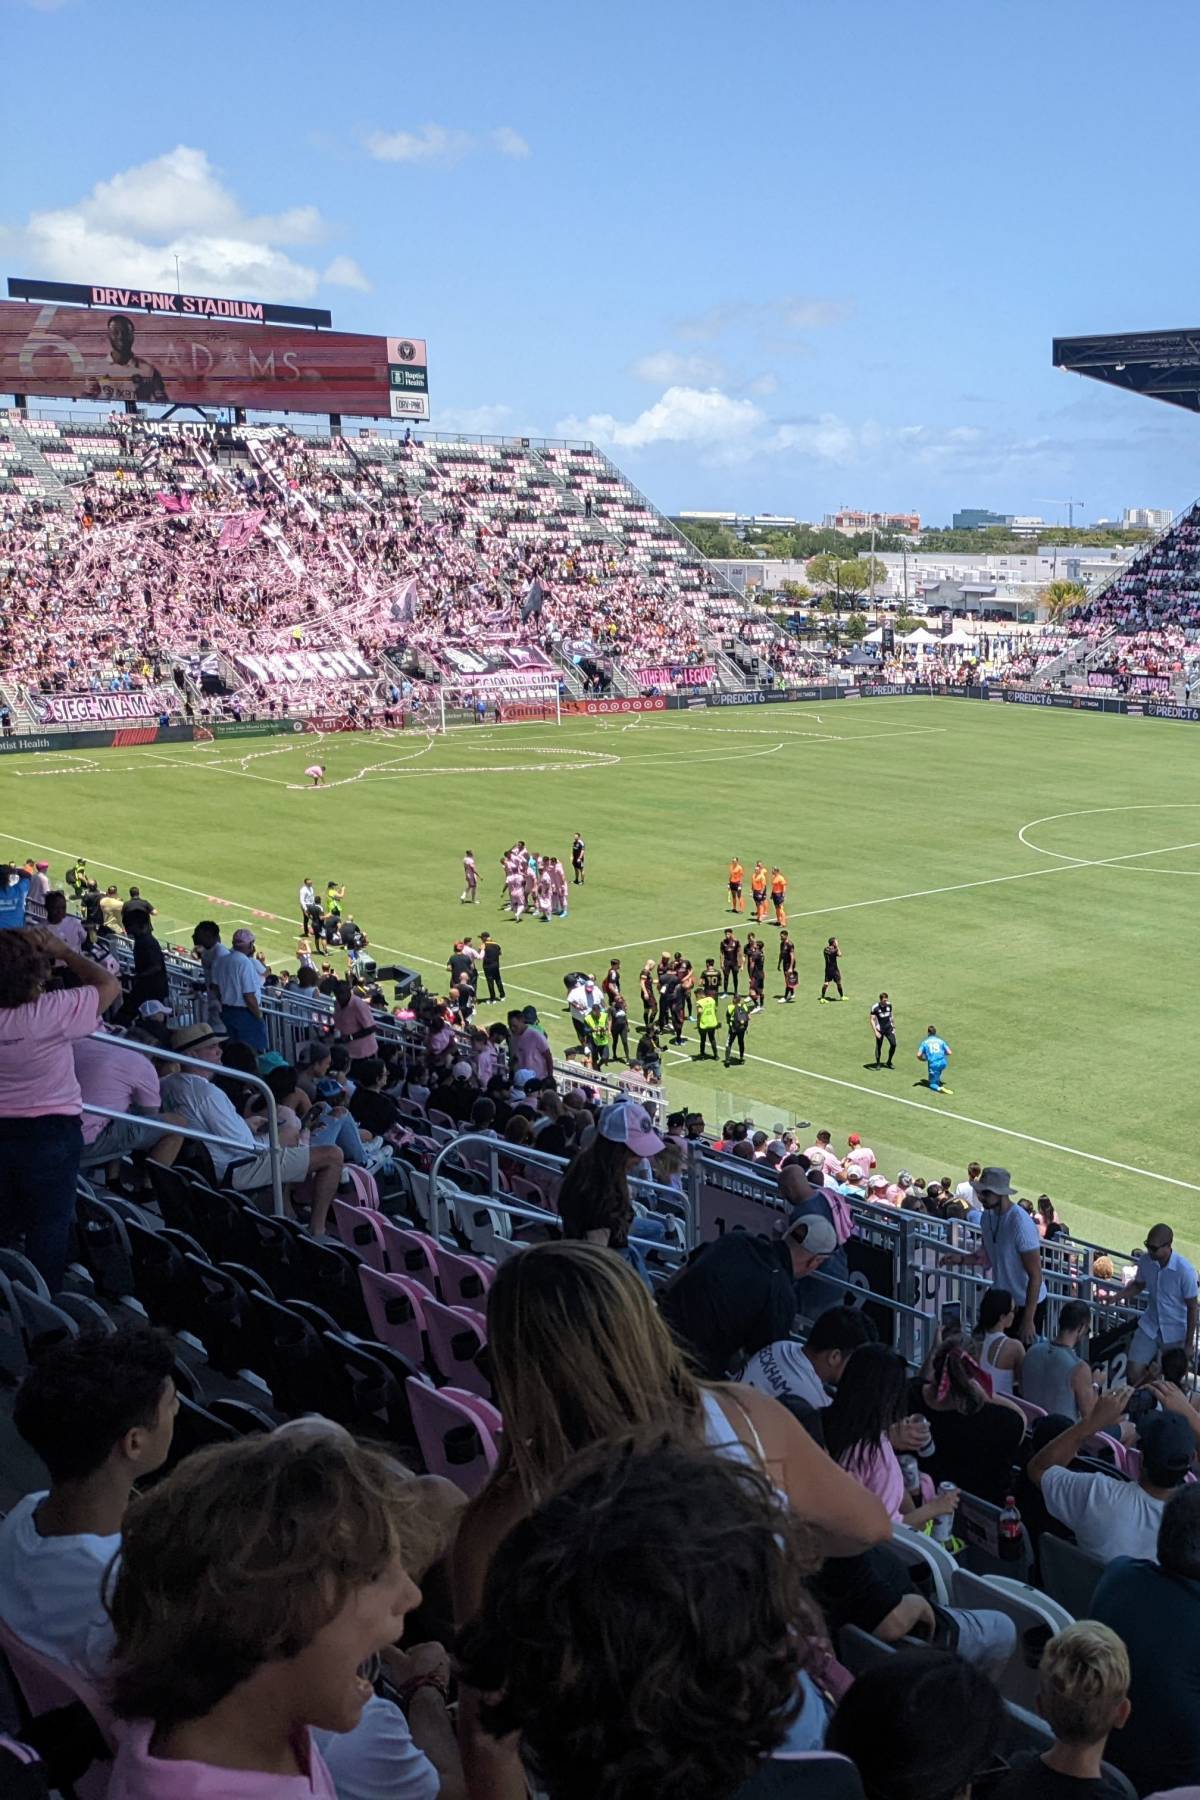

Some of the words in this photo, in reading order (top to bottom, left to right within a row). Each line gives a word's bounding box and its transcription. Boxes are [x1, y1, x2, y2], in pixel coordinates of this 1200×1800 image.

[182, 296, 264, 319] STADIUM
[163, 341, 302, 382] ADAMS
[143, 422, 179, 437] VICE
[182, 423, 217, 439] CITY
[1088, 673, 1113, 688] CIUDAD
[720, 692, 758, 705] PREDICT
[759, 691, 765, 703] 6
[872, 686, 906, 695] PREDICT
[907, 686, 913, 694] 6
[1014, 692, 1046, 705] PREDICT
[1046, 695, 1052, 705] 6
[53, 697, 98, 722] SIEGE
[1156, 705, 1192, 719] PREDICT
[1192, 710, 1199, 720] 6
[19, 738, 50, 749] Health
